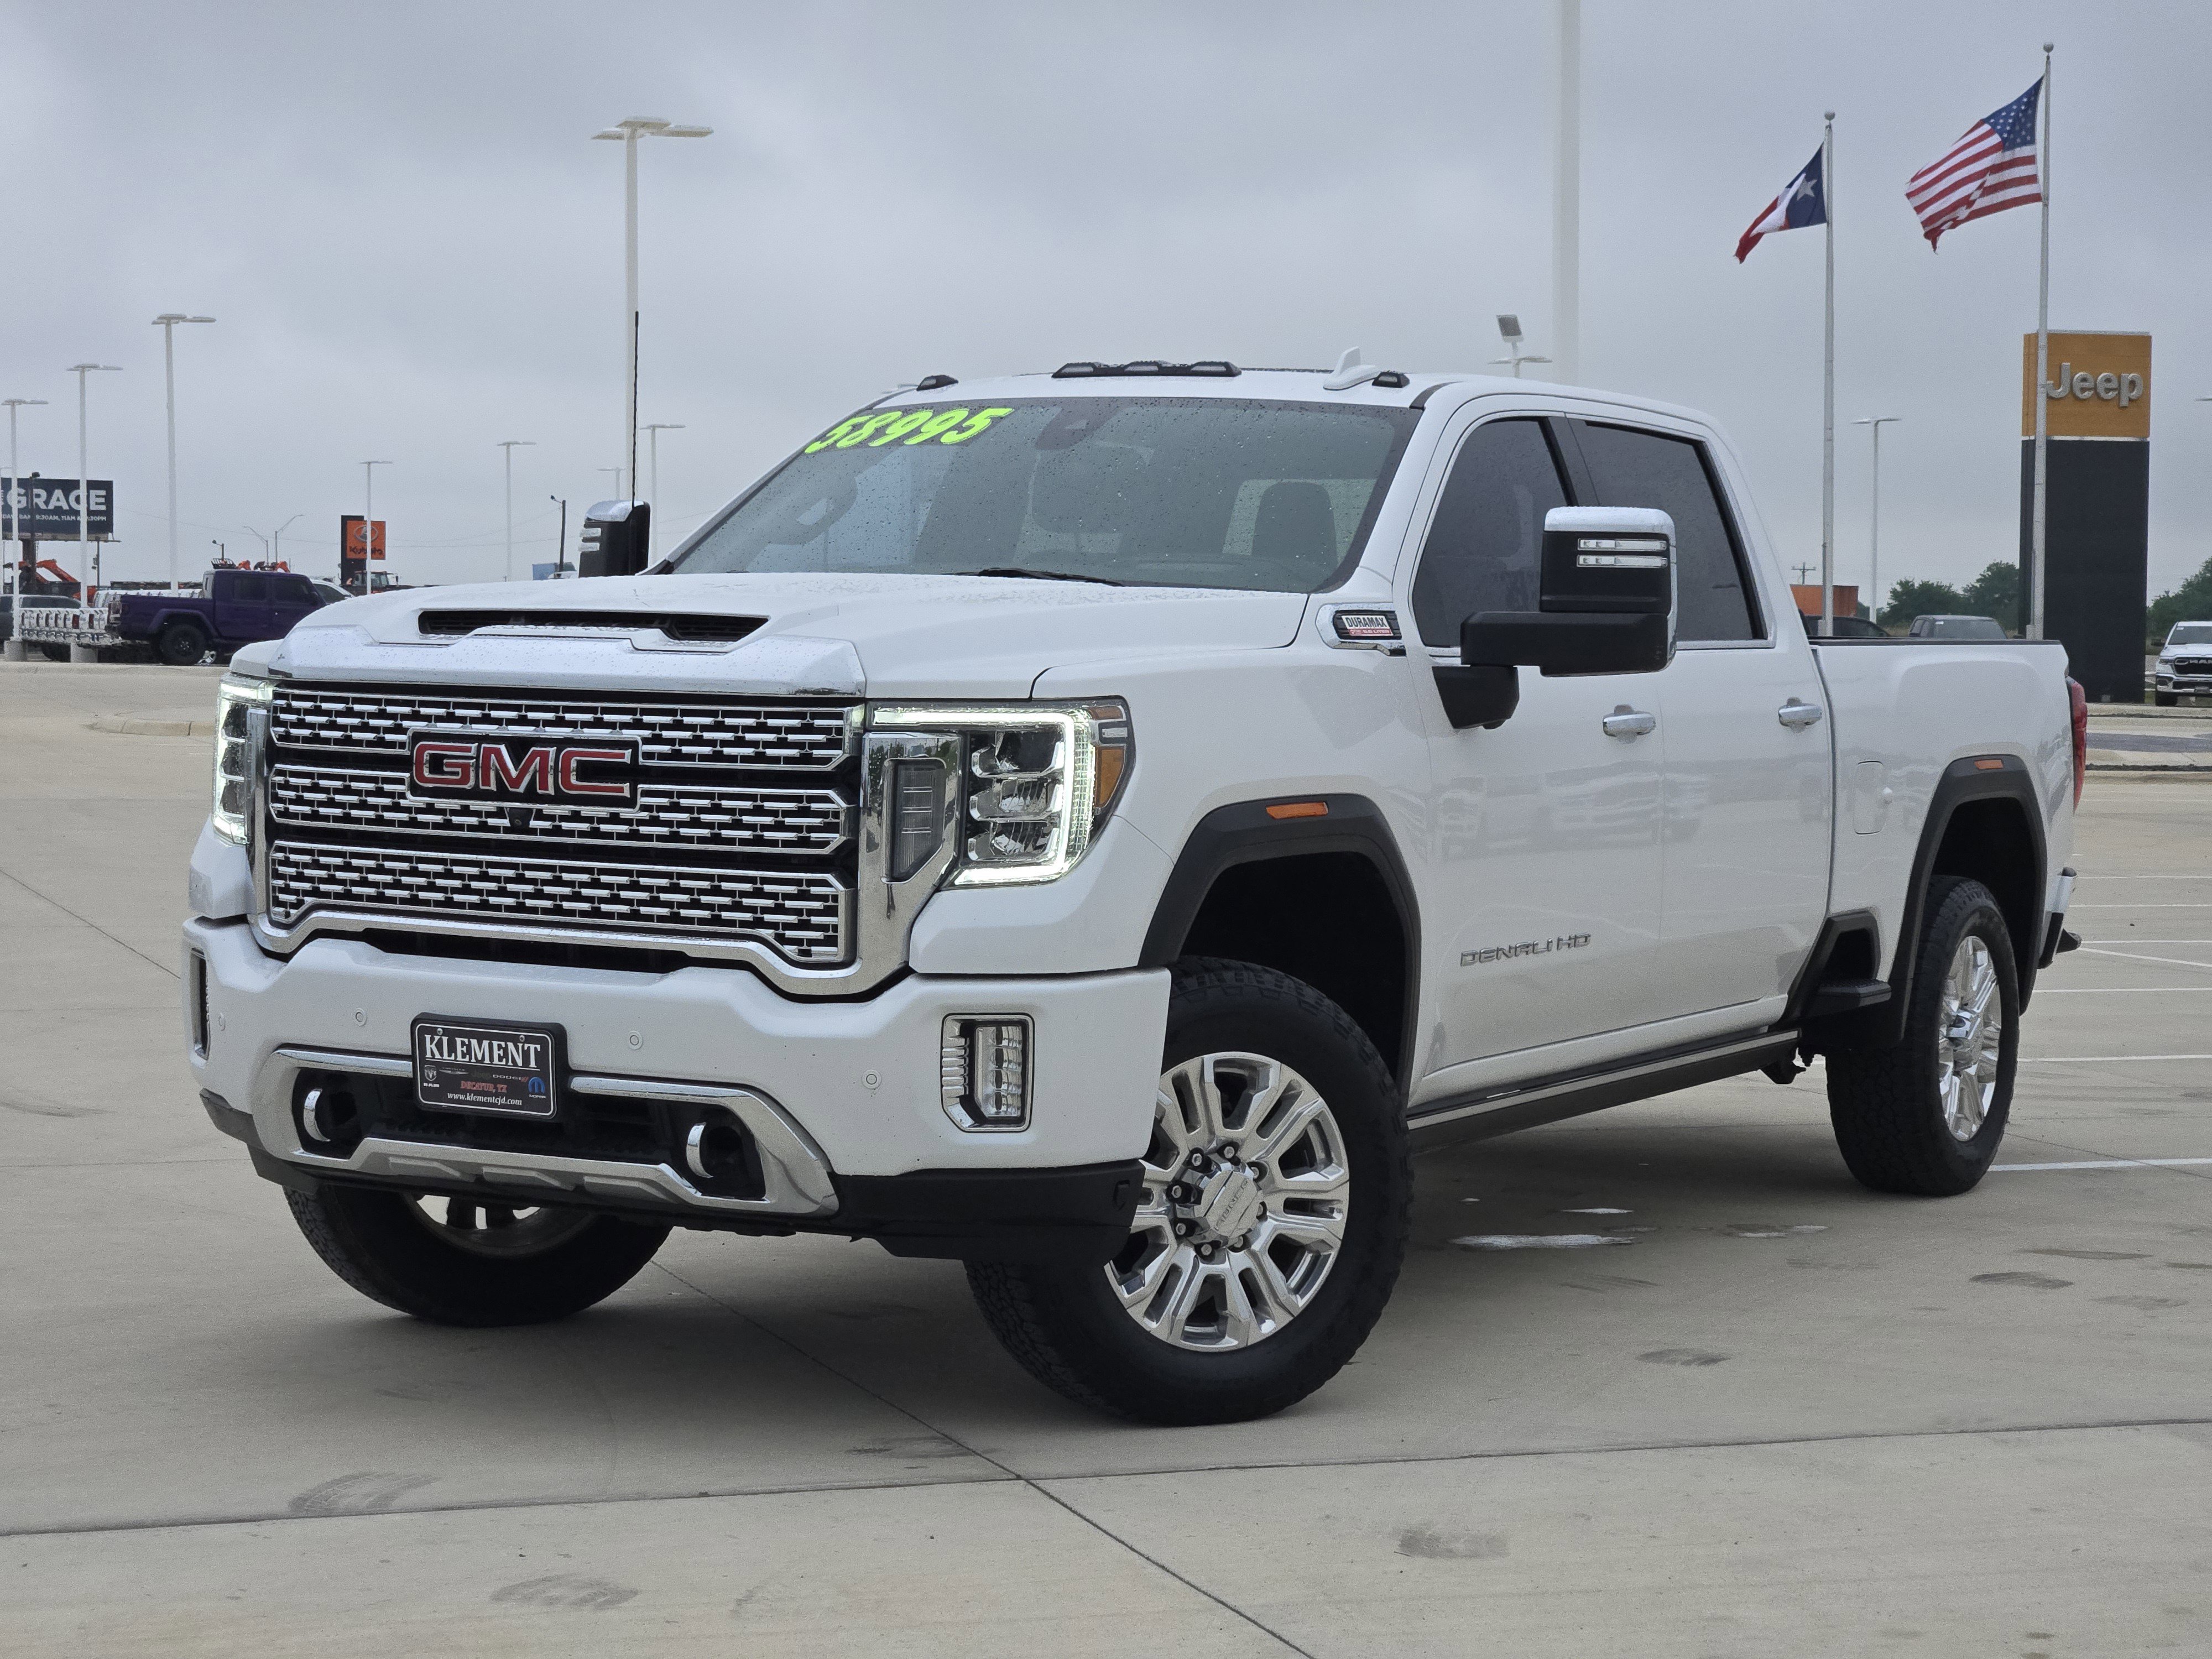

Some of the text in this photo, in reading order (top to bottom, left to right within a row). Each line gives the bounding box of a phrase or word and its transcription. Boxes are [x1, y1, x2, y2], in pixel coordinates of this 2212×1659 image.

[2046, 362, 2143, 407] Jeep
[804, 408, 1015, 454] 58995
[7, 487, 107, 510] GRACE
[349, 545, 383, 555] Kubta
[1345, 617, 1387, 628] DURAMAX
[413, 741, 632, 798] GMC
[1460, 932, 1592, 967] DENALI HD
[424, 1034, 541, 1068] KLEMENT
[447, 1092, 522, 1105] www.klementcjd.com
[497, 1084, 507, 1093] TX
